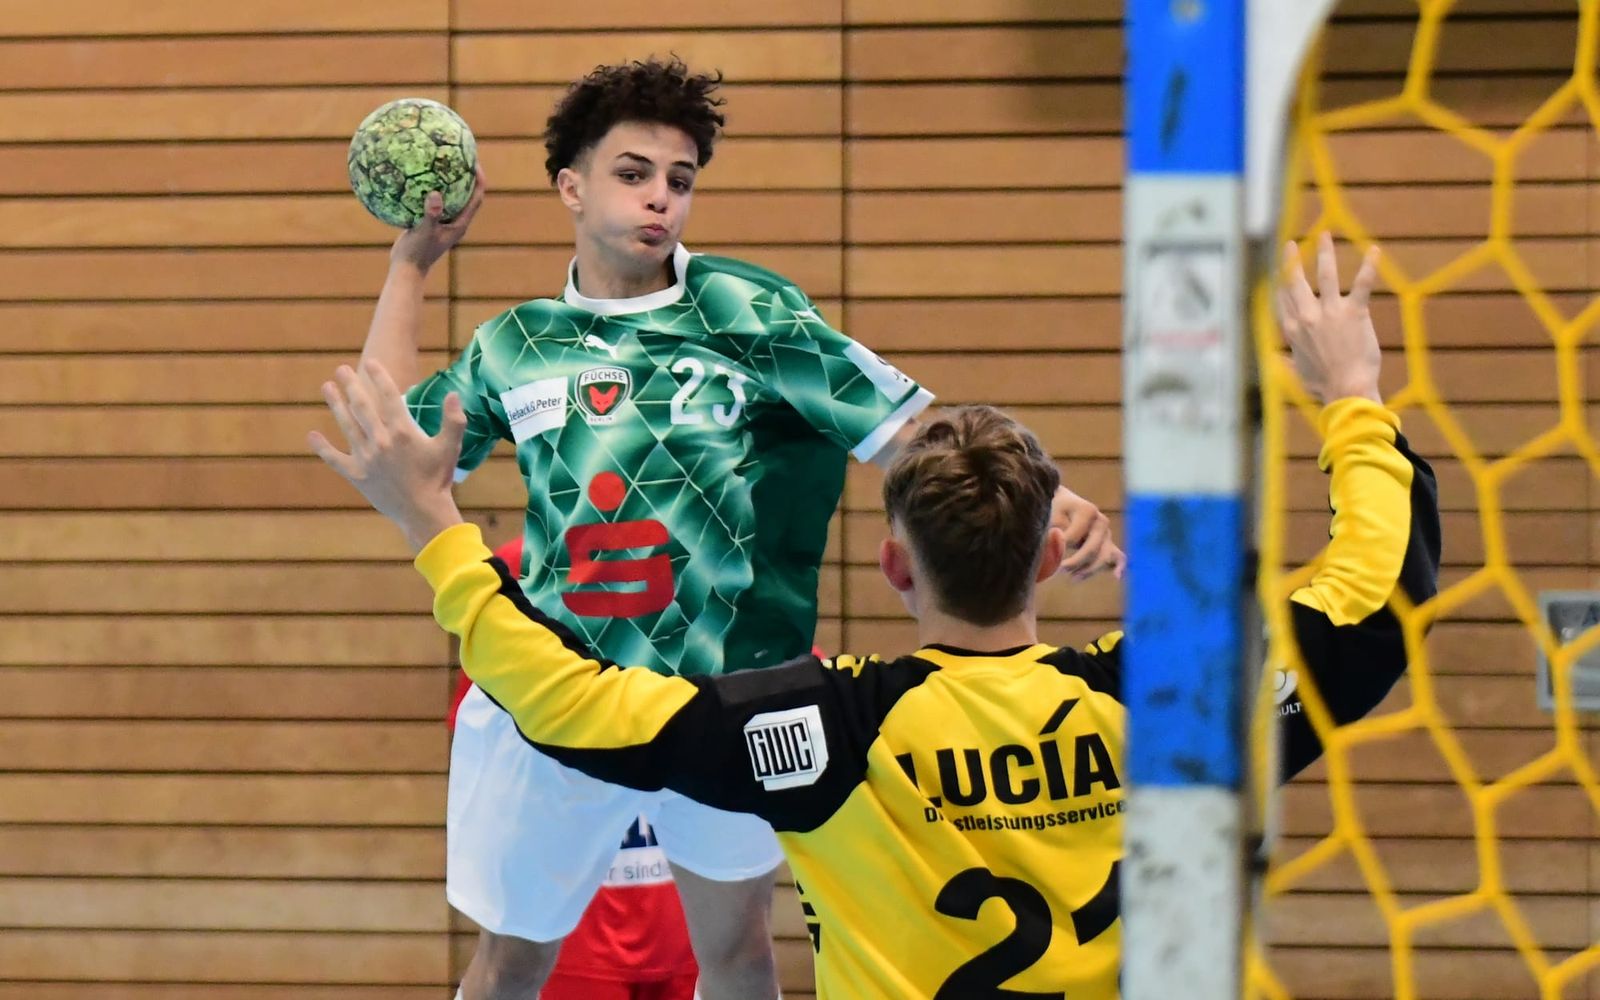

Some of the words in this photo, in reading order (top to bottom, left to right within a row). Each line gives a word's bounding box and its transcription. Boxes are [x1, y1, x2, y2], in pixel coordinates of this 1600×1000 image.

[507, 397, 562, 421] ieback&Peter
[671, 357, 747, 428] 23
[746, 721, 813, 778] GWC
[924, 799, 1128, 832] Dstleistungsservice
[932, 859, 1121, 1000] 2
